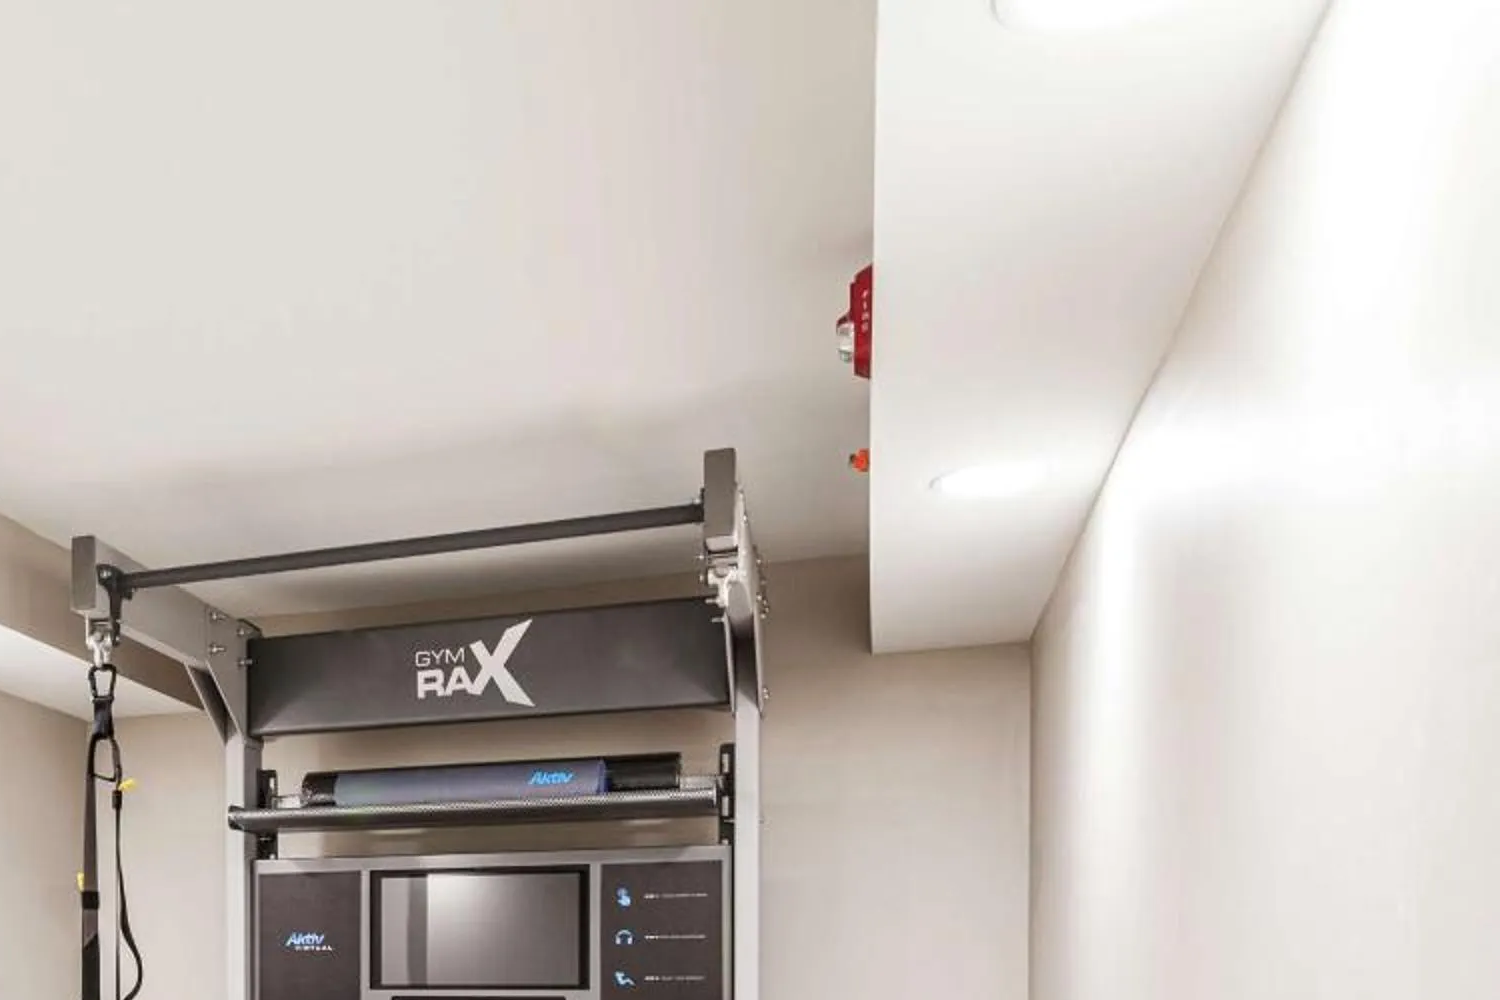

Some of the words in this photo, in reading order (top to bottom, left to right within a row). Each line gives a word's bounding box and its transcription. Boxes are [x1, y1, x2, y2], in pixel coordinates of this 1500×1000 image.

[415, 647, 465, 667] GYM
[417, 618, 536, 707] RAX
[527, 771, 575, 785] Aktiv
[285, 931, 325, 946] Aktiv
